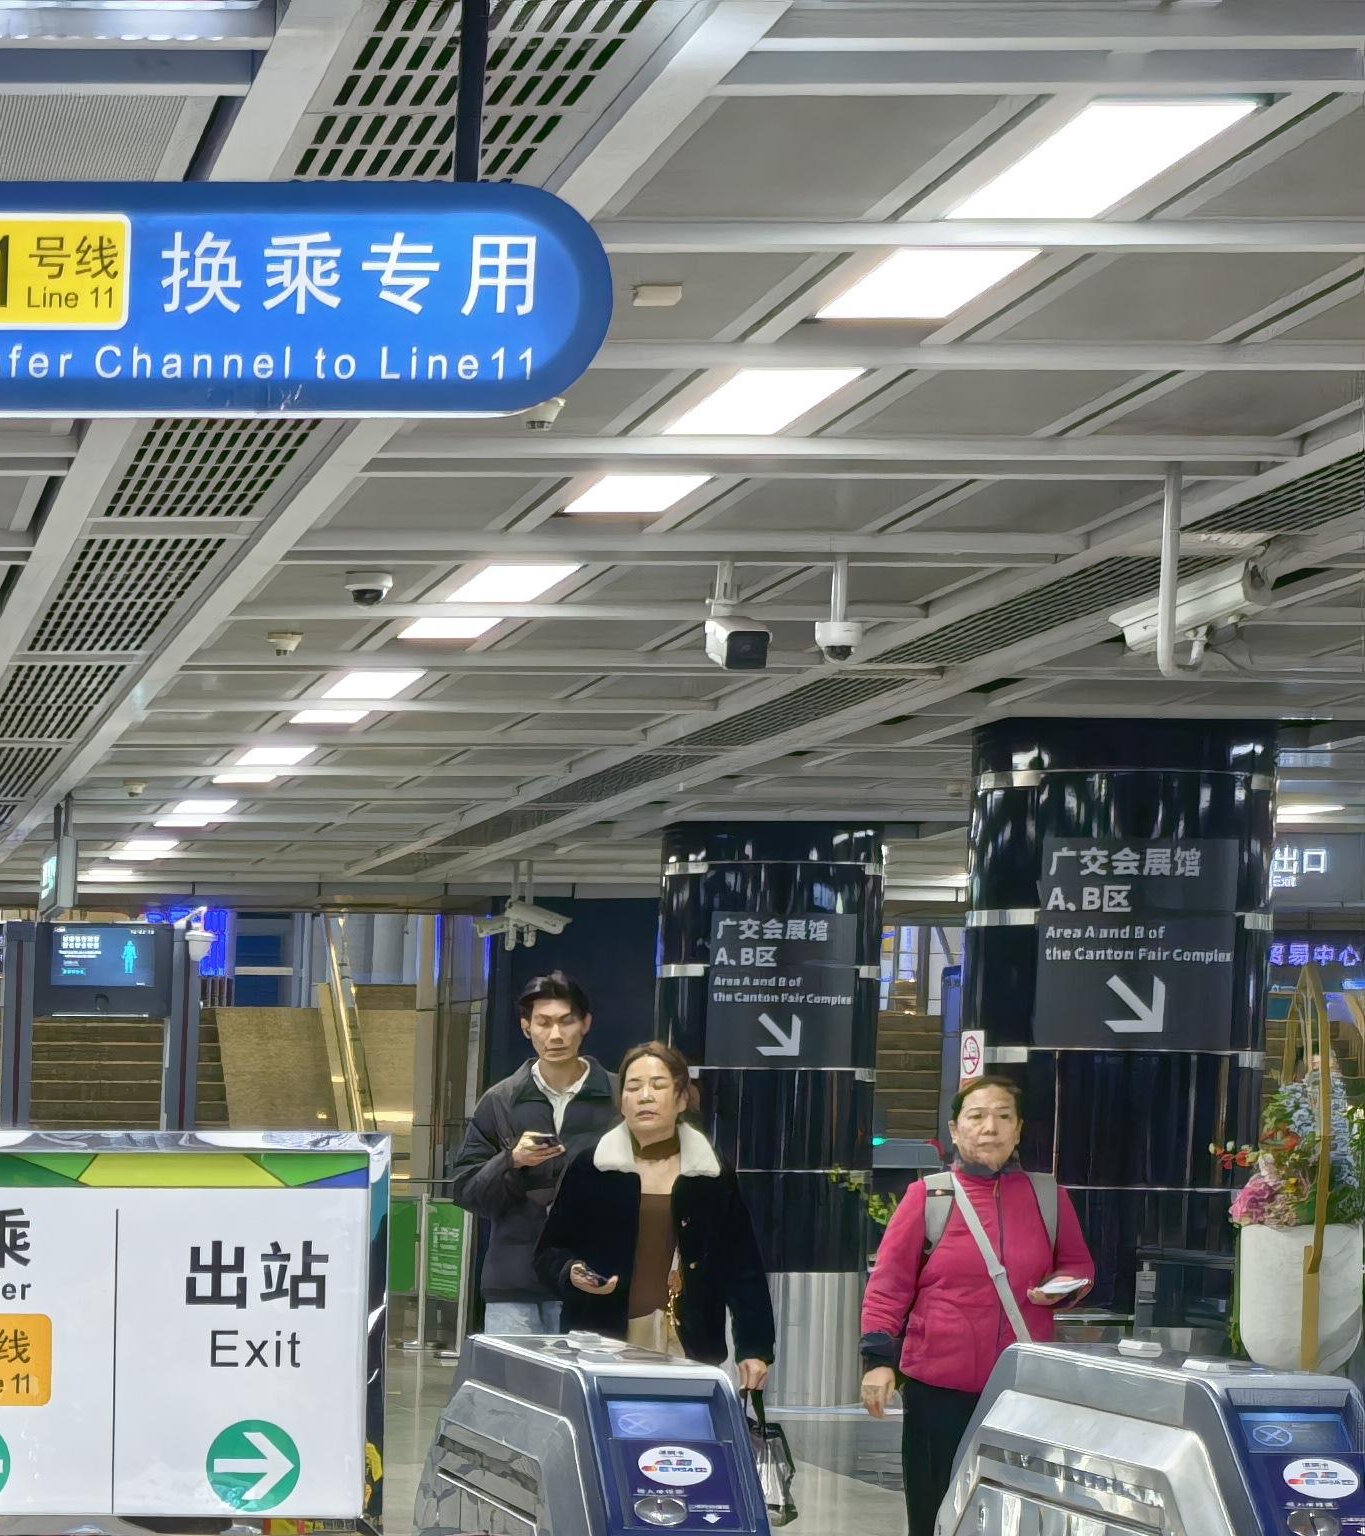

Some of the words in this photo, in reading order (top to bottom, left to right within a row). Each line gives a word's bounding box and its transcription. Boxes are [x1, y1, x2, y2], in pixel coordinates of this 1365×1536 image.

[28, 234, 119, 281] 号线
[161, 230, 538, 317] 换乘专用
[27, 285, 78, 310] Line
[89, 286, 114, 310] 11
[95, 344, 292, 381] Channel
[315, 347, 357, 381] to
[1048, 845, 1202, 877] 广交会展馆
[1273, 845, 1328, 875] 出口
[1045, 883, 1133, 913] A、B区
[185, 1239, 329, 1310] 出站
[210, 1329, 302, 1369] Exit
[11, 1374, 32, 1395] 11
